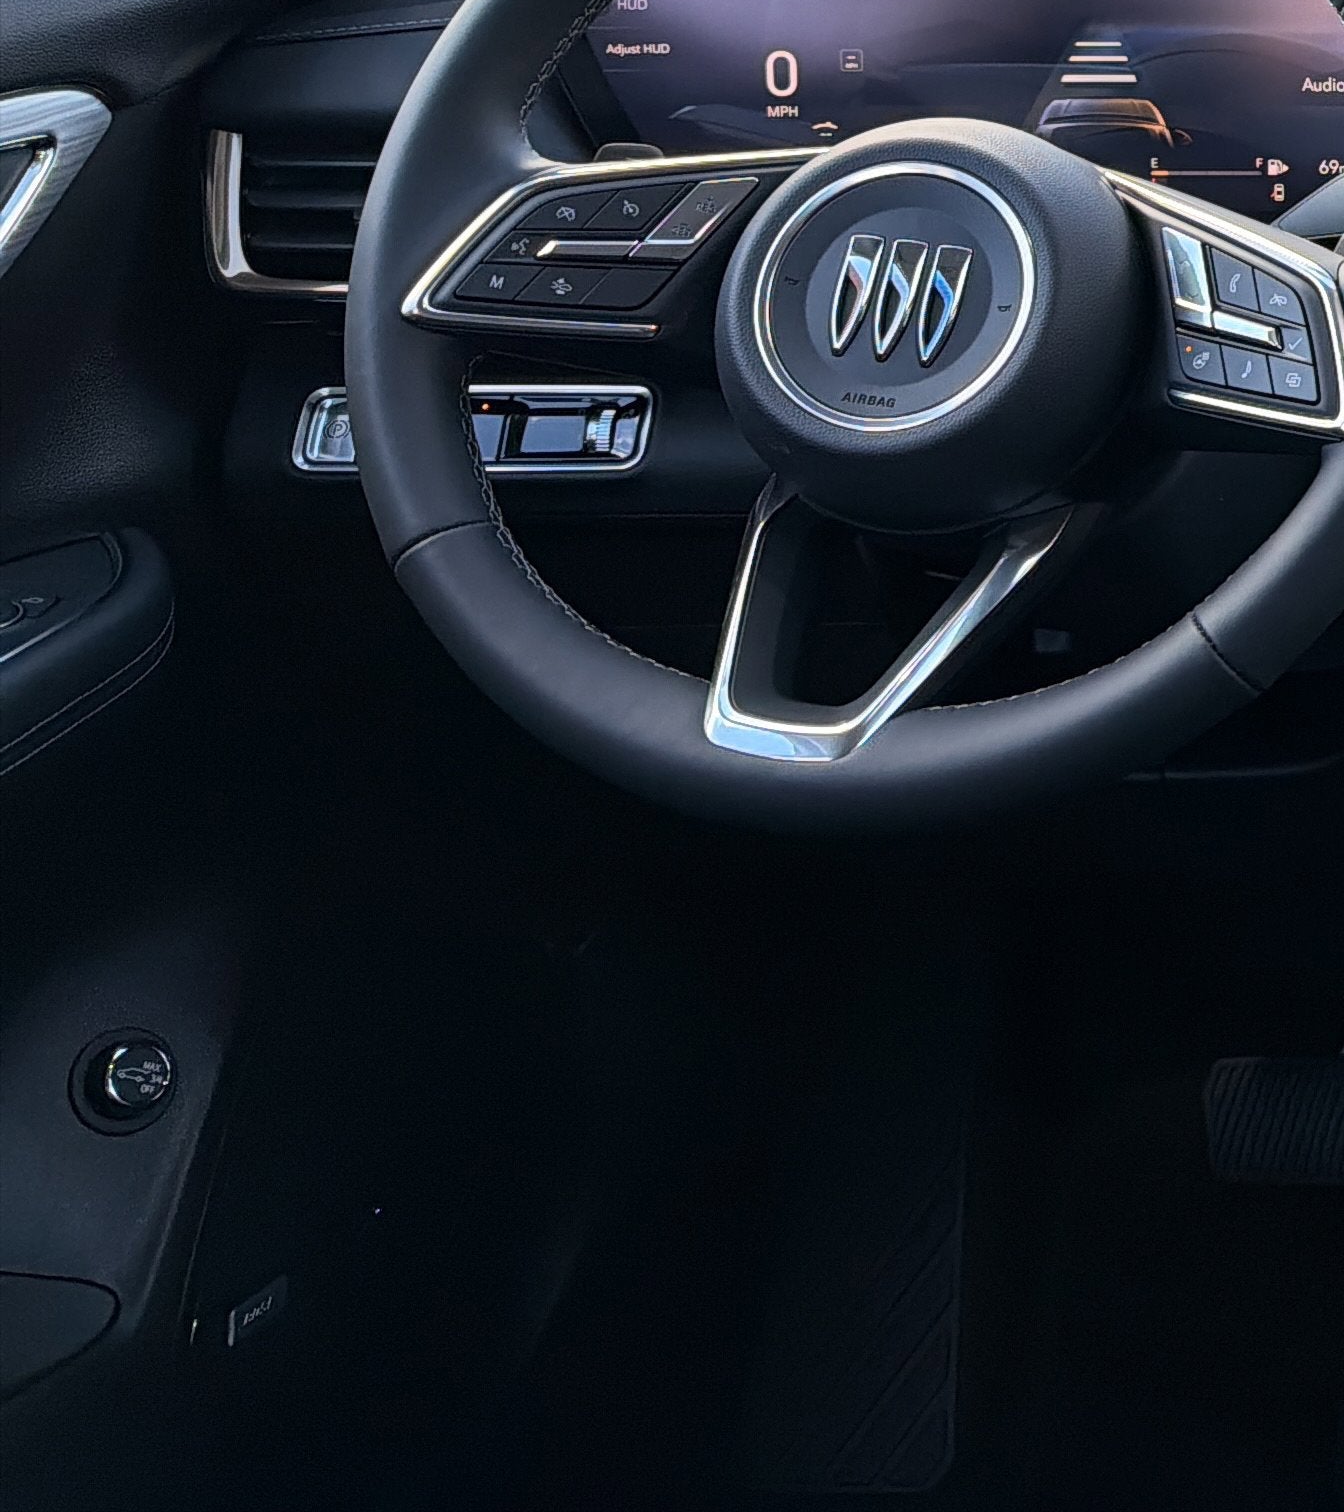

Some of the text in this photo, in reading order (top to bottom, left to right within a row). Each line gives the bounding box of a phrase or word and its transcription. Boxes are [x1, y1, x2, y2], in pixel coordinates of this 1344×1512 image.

[606, 43, 671, 57] Adjust HUD
[765, 50, 798, 98] 0
[767, 105, 799, 118] MPH
[1151, 157, 1159, 169] E
[1255, 158, 1264, 169] F
[490, 275, 505, 289] M
[841, 392, 896, 409] AIRBAG
[143, 1060, 162, 1073] MAX
[140, 1083, 156, 1094] OFF
